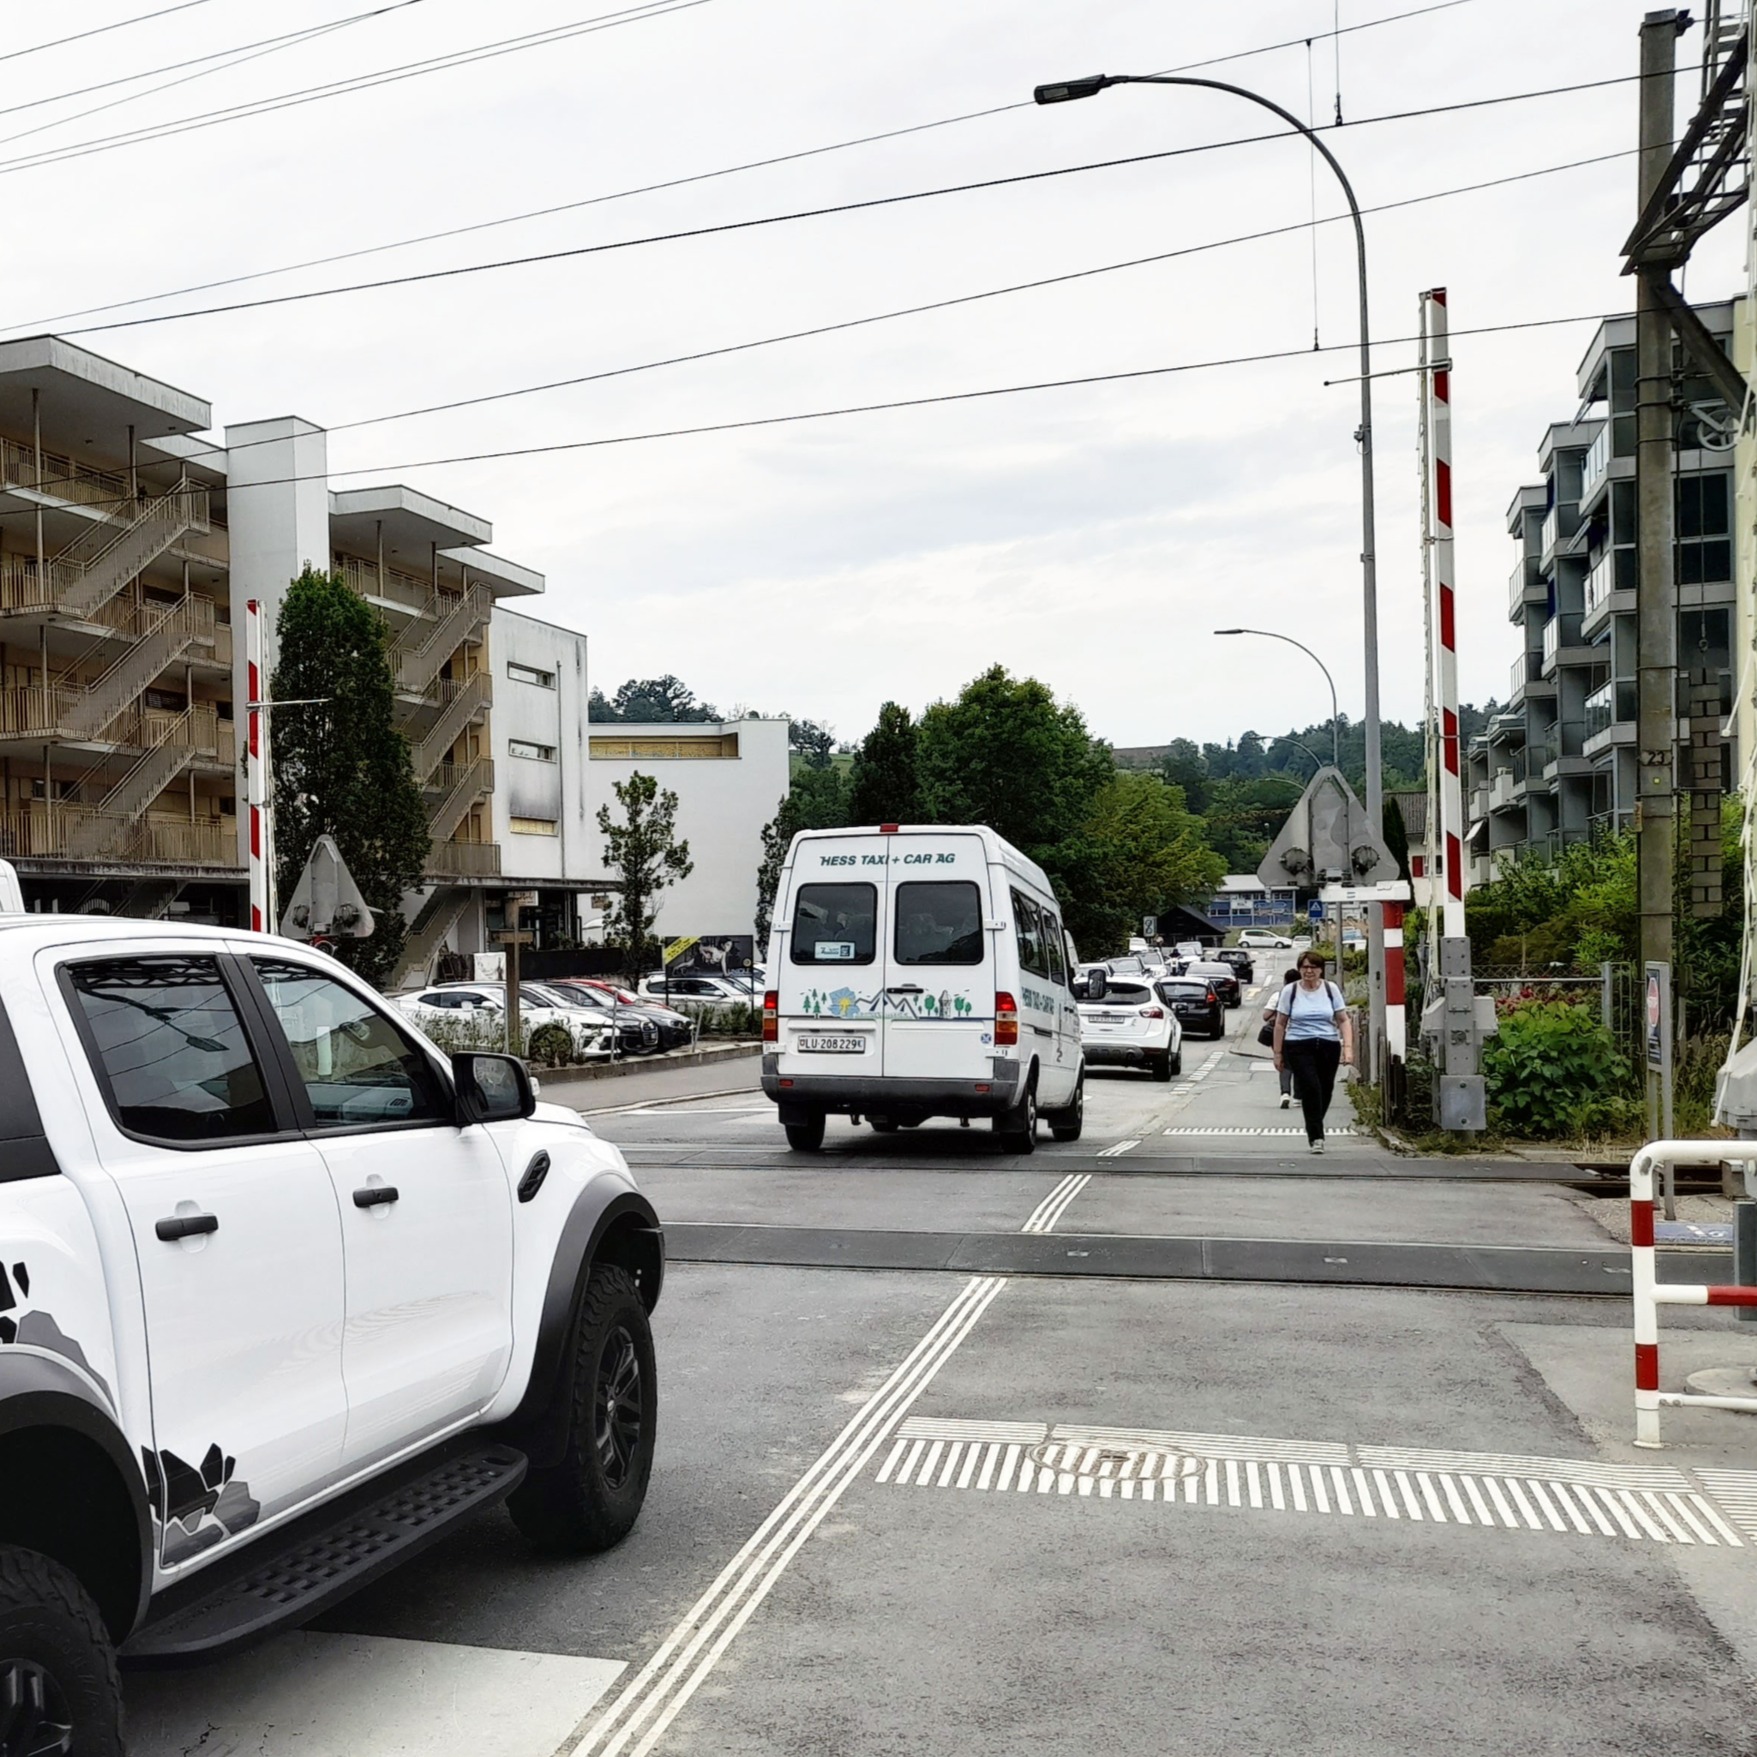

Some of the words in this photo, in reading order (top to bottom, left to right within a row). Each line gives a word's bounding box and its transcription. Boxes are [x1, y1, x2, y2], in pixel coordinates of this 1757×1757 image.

[820, 855, 857, 866] HESS
[861, 854, 890, 865] TAXI
[891, 856, 900, 864] +
[903, 853, 933, 864] CAR
[935, 852, 956, 863] AG
